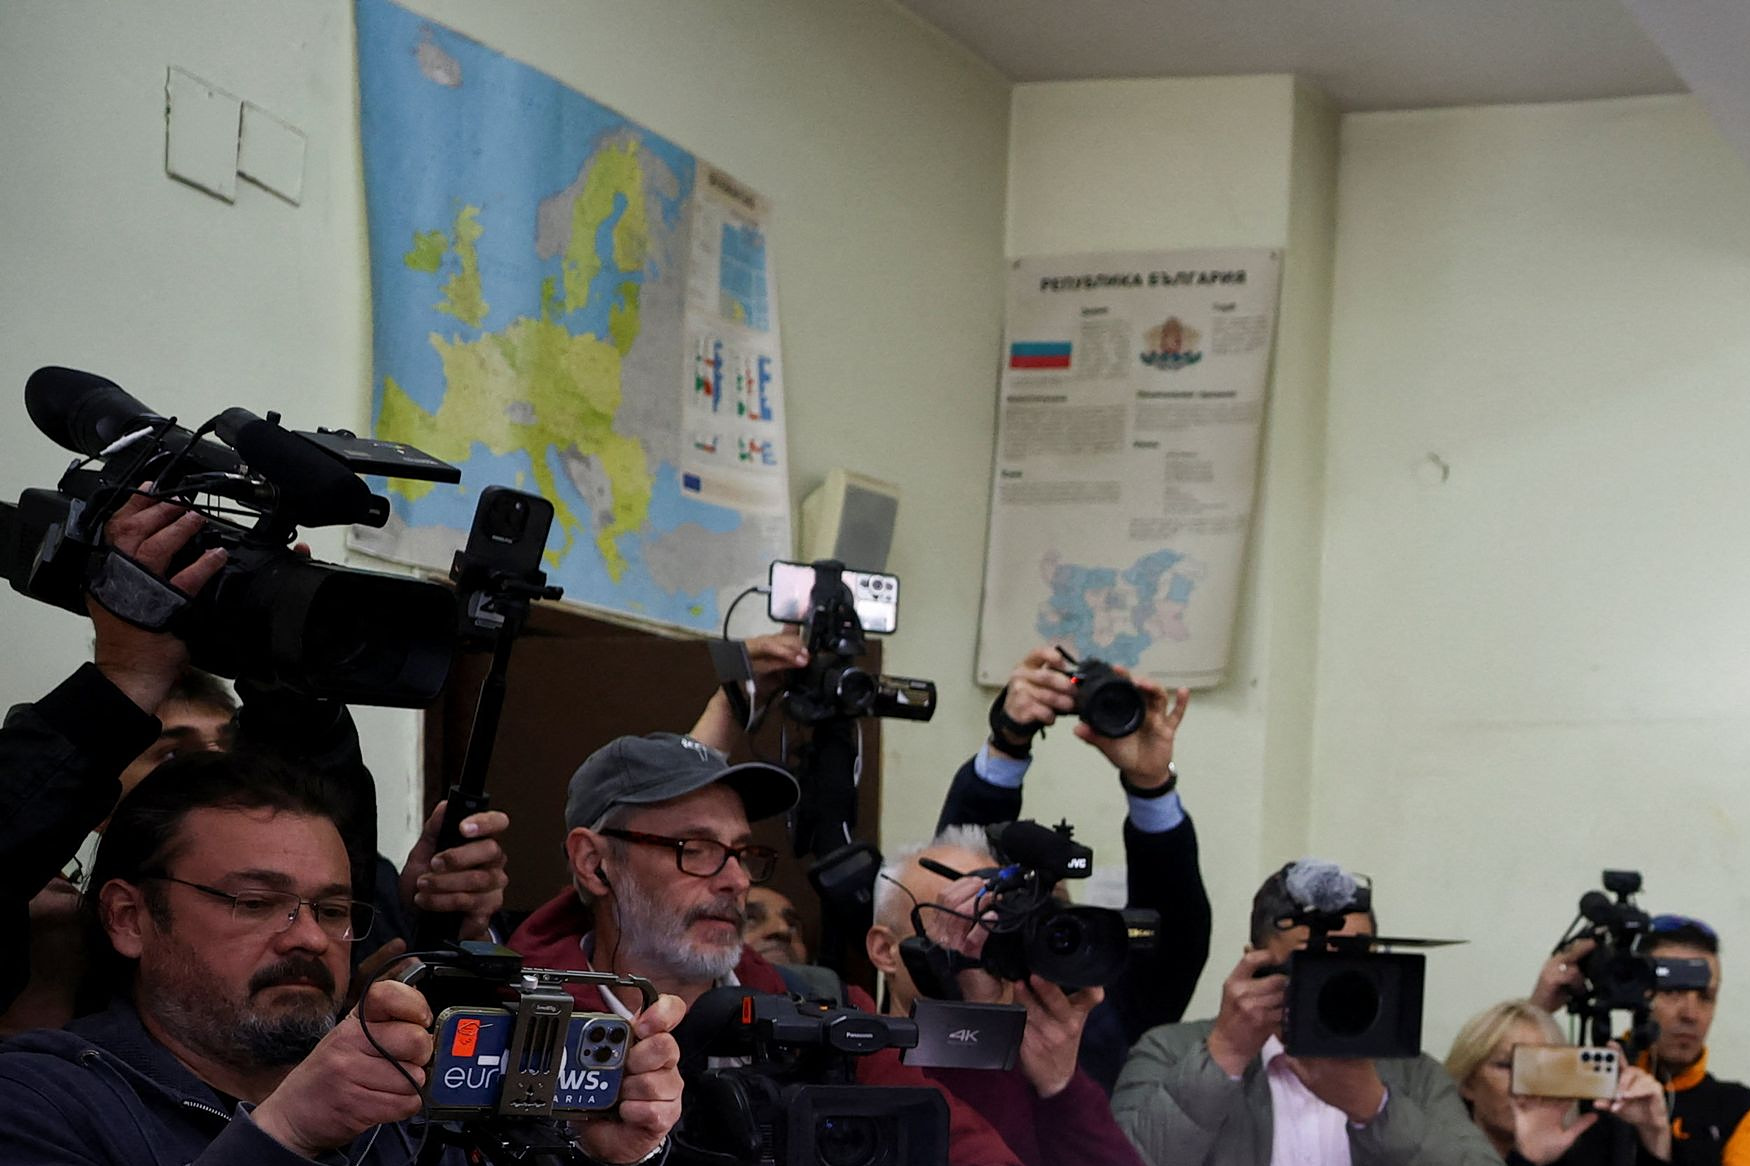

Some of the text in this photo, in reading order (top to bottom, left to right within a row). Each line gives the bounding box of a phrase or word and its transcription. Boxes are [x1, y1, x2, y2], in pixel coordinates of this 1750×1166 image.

[1067, 858, 1087, 869] JVC
[948, 1029, 980, 1042] 4K
[444, 1067, 609, 1090] eurws.
